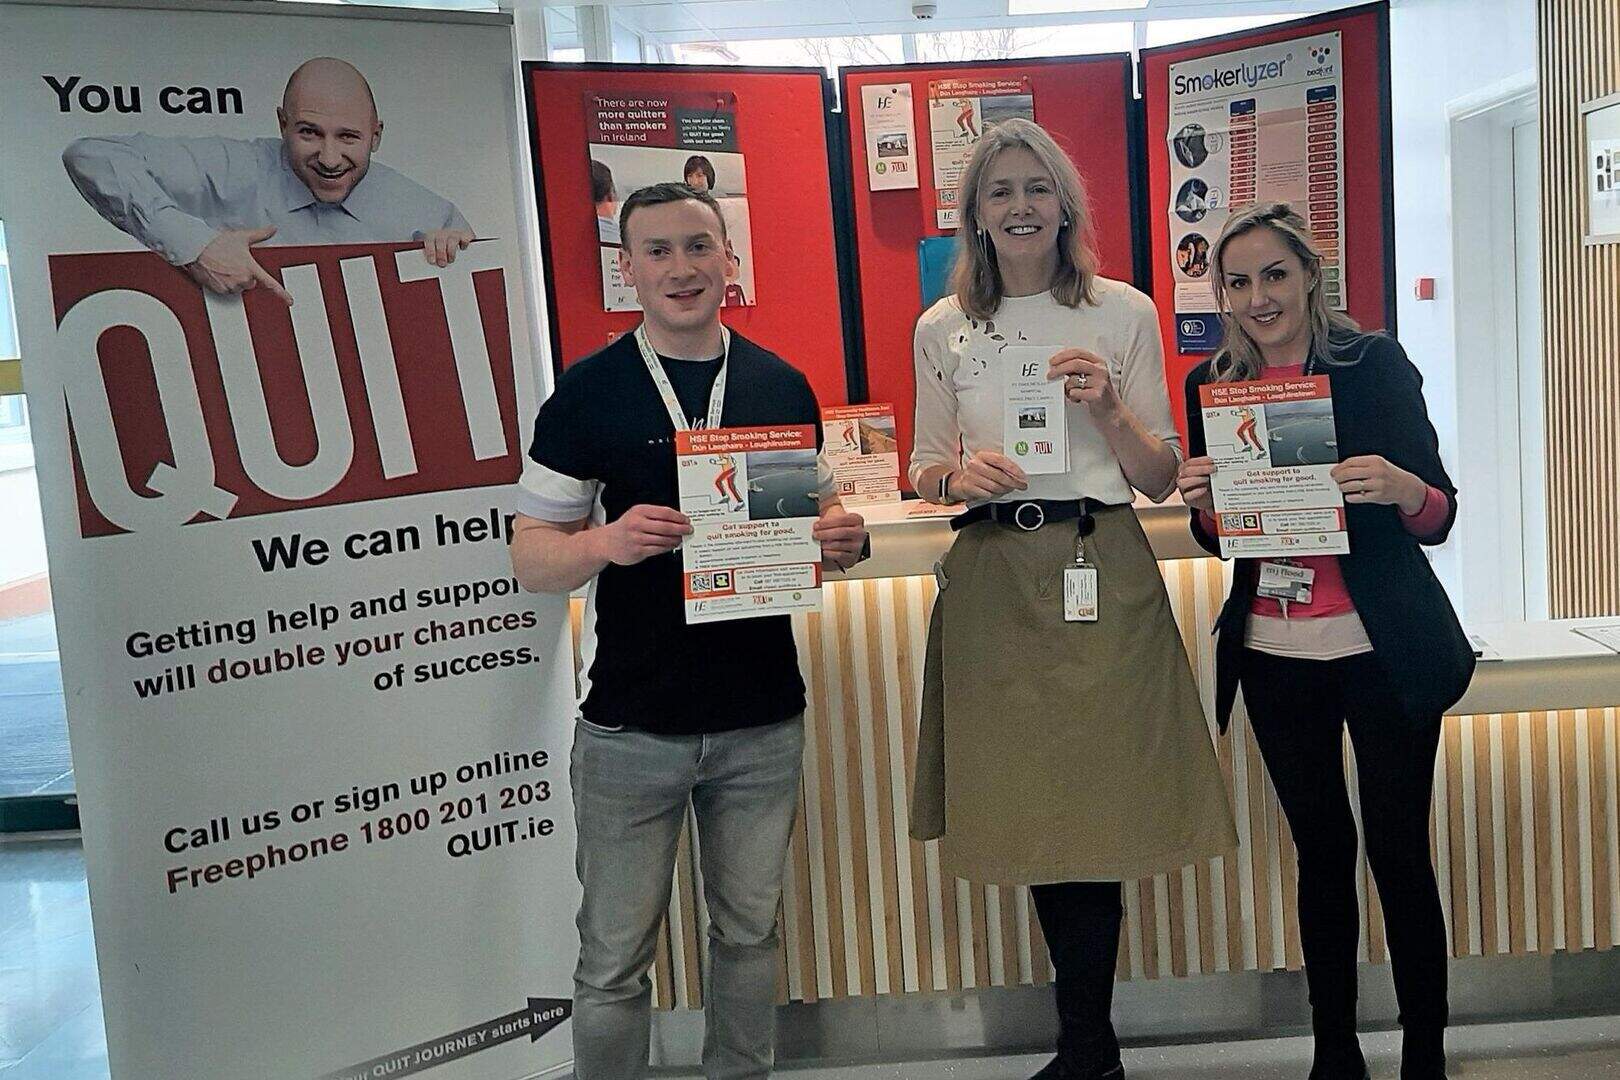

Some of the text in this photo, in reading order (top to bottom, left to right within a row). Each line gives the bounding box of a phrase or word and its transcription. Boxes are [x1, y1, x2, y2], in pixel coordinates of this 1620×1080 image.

[42, 75, 244, 115] You can
[596, 98, 668, 108] There are now
[598, 110, 667, 120] more quitters
[599, 121, 667, 130] than smokers
[600, 133, 647, 142] in Ireland
[55, 240, 508, 533] QUIT
[1211, 388, 1228, 396] HSE
[1230, 386, 1248, 395] Stop
[1248, 384, 1284, 394] Smoking
[690, 430, 802, 443] HSE Stop Smoking Service:
[1250, 477, 1280, 486] smoking
[1262, 468, 1291, 477] support
[724, 530, 758, 540] smoking
[739, 522, 769, 530] support
[252, 533, 329, 572] We
[344, 524, 420, 560] can
[126, 576, 520, 658] Getting help and suppor
[133, 610, 538, 699] will double your chances
[374, 646, 540, 691] of success.
[164, 750, 549, 854] Call us or sign up online
[166, 780, 551, 894] Freephone 1800 201 203
[446, 817, 555, 858] QUIT.ie
[372, 1054, 412, 1078] QUIT
[413, 1030, 488, 1065] JOURNEY
[492, 1017, 530, 1039] starts
[533, 1006, 564, 1024] here
